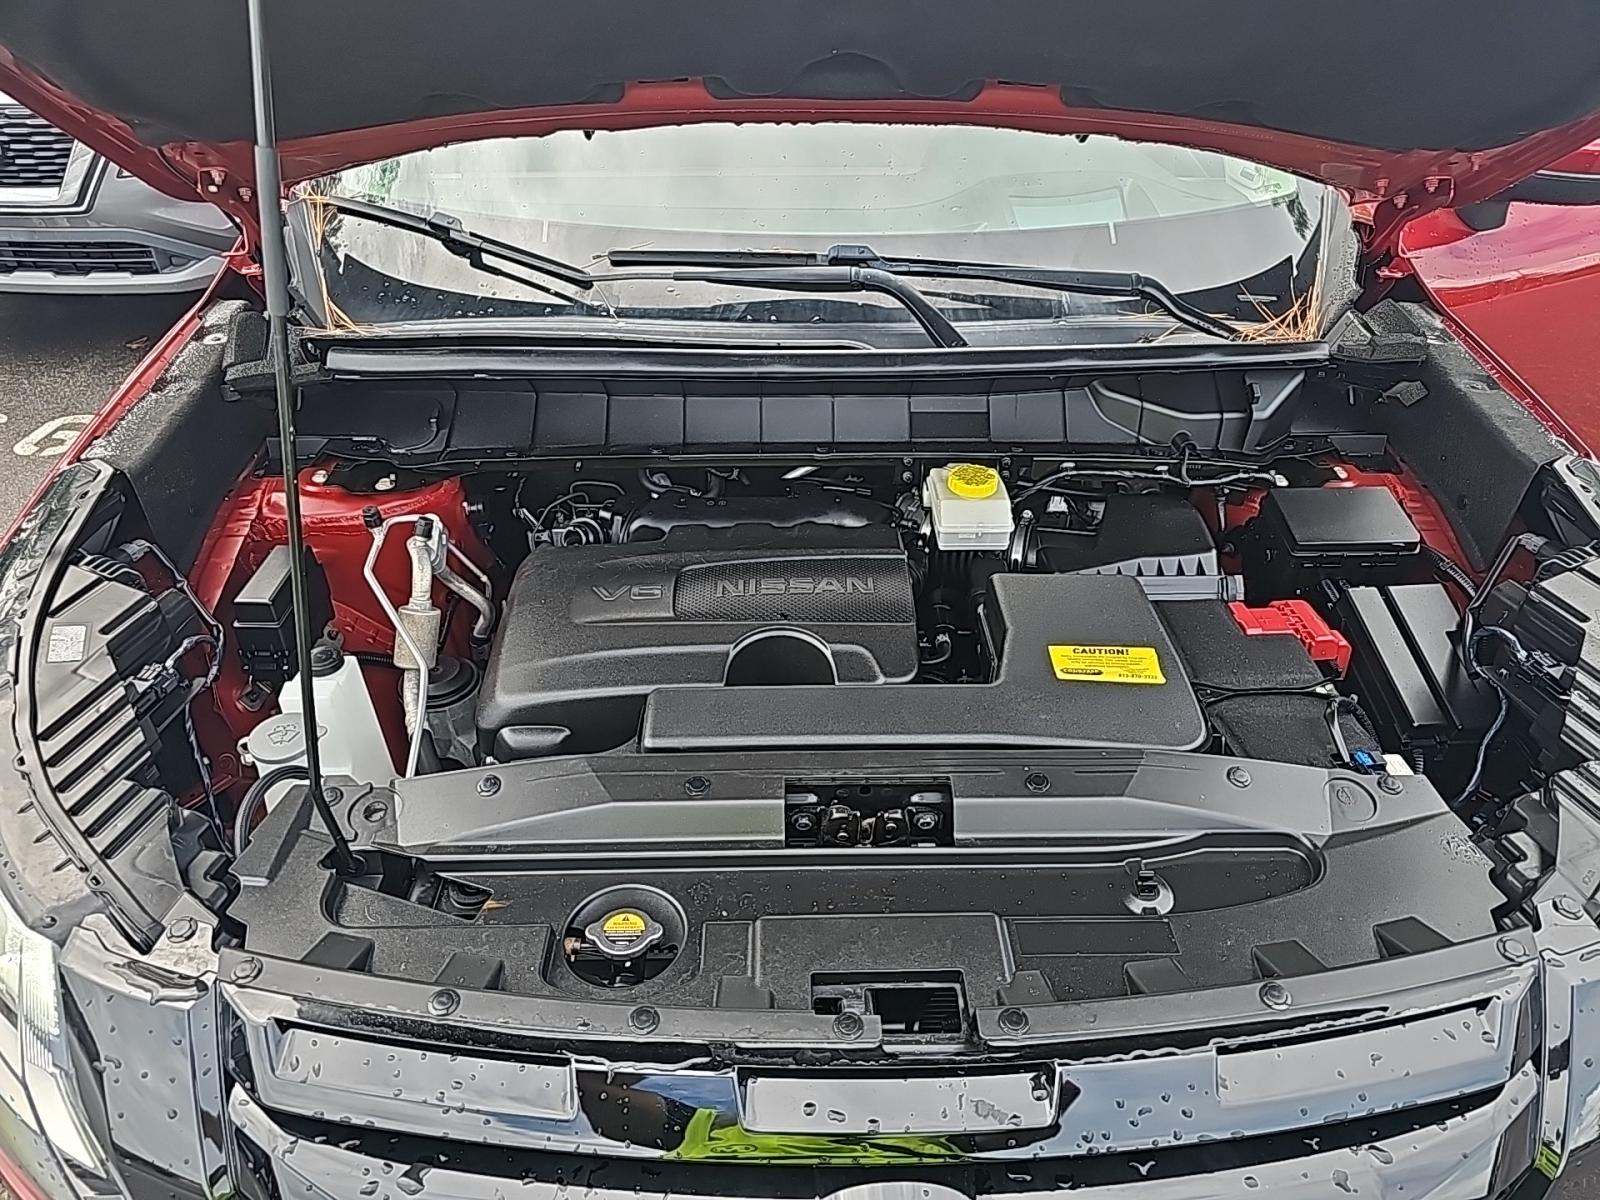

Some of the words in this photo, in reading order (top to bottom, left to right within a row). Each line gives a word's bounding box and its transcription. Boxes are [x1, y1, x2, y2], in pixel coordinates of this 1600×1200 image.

[592, 583, 663, 601] V6
[716, 577, 875, 597] NISSAN
[1072, 647, 1129, 656] CAUTION!
